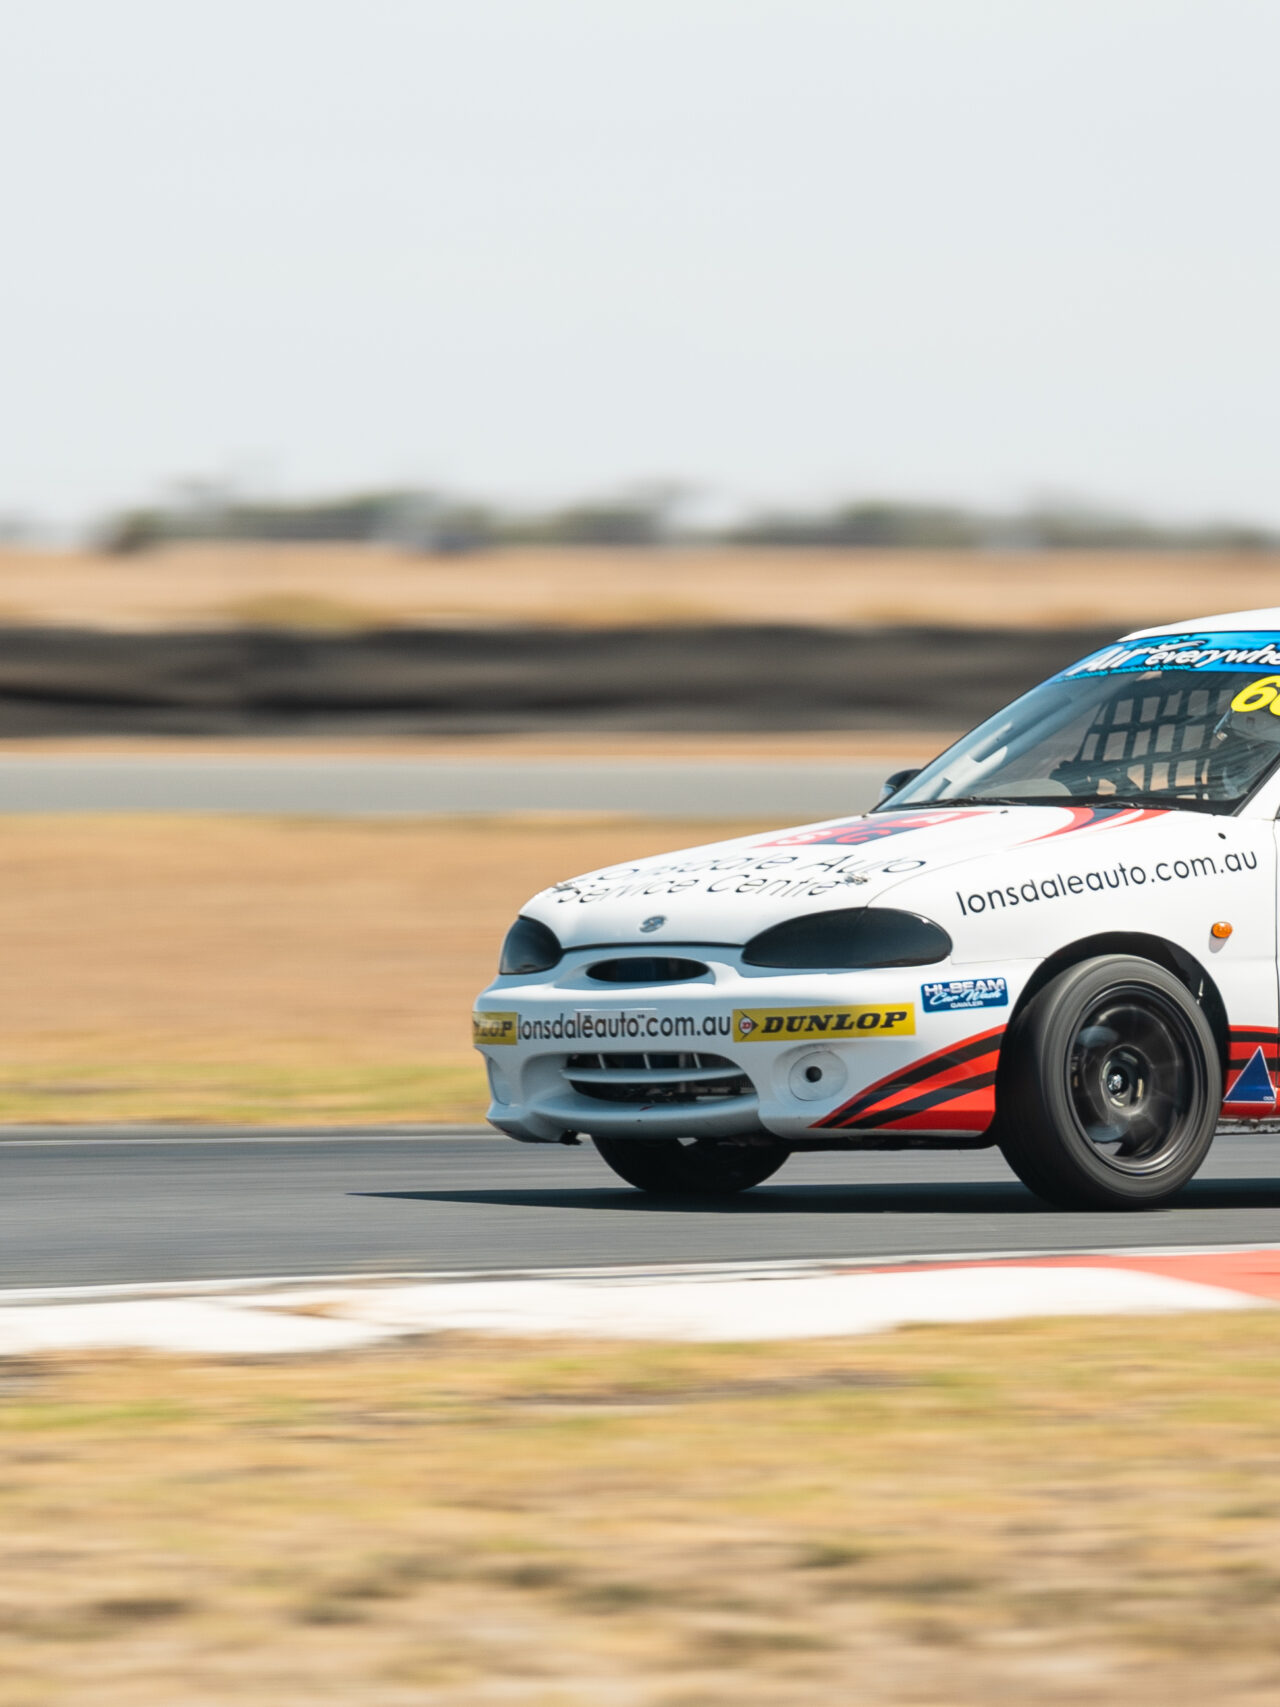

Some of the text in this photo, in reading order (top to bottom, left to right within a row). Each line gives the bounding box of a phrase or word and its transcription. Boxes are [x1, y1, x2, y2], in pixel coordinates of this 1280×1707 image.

[955, 850, 1258, 916] lonsdaleauto.com.au
[924, 978, 1005, 997] HI-BEAM
[929, 991, 959, 1005] Car
[518, 1011, 731, 1040] lonsdaleauto.com.au
[761, 1011, 908, 1034] DUNLOP
